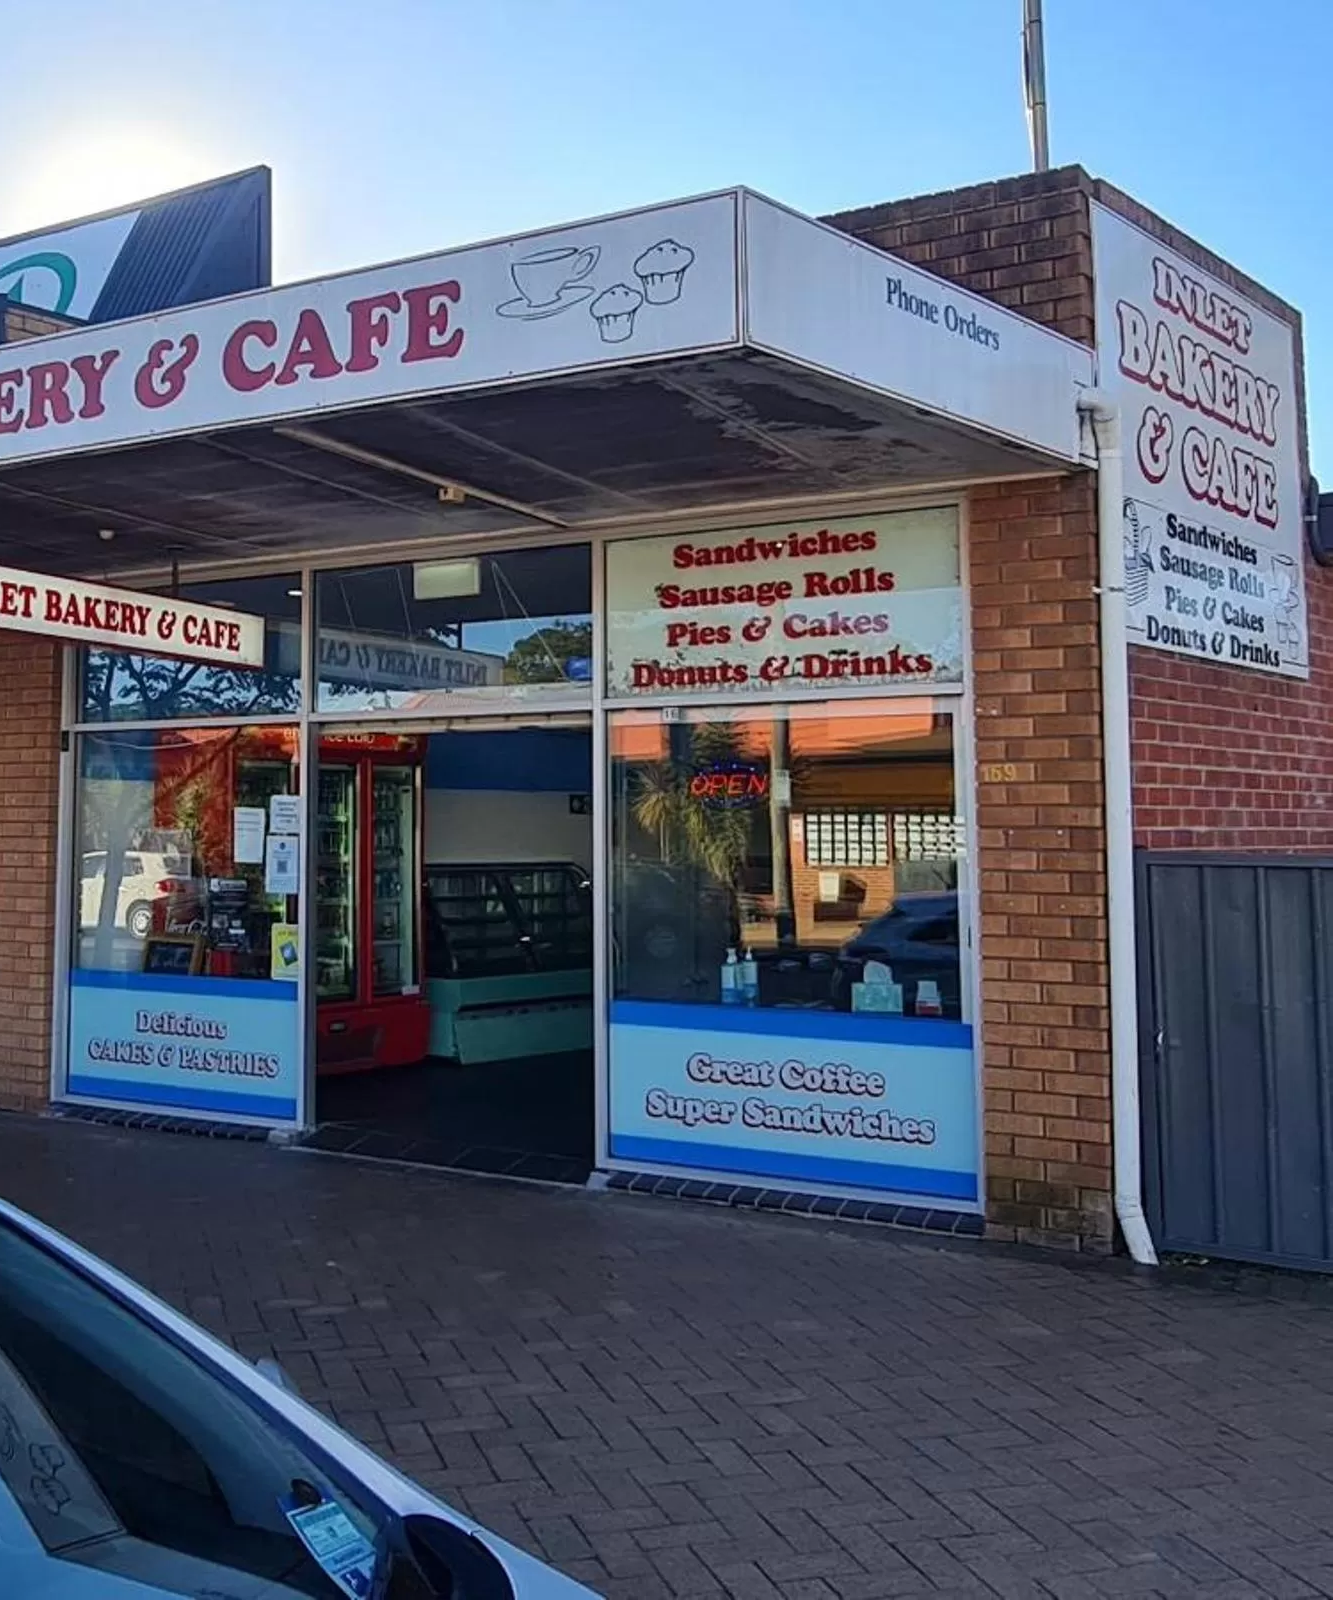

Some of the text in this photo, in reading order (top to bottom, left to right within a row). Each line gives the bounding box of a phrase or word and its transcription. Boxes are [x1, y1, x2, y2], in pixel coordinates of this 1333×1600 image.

[886, 277, 1000, 351] Phone Orders
[1153, 257, 1252, 354] INLET
[135, 334, 199, 408] &
[223, 281, 464, 391] CAFE
[1117, 299, 1279, 447] BAKERY
[1138, 405, 1279, 529] & CAFE
[673, 530, 877, 569] Sandwiches
[1167, 513, 1257, 565] Sandwiches
[658, 567, 895, 609] Sausage Rolls
[1160, 546, 1265, 599] Sausage Rolls
[45, 589, 151, 639] BAKERY
[157, 610, 177, 640] &
[182, 614, 242, 652] CAFE
[666, 610, 889, 647] Pies & Cakes
[1165, 586, 1265, 633] Pies & Cakes
[632, 645, 933, 688] Donuts & Drinks
[1146, 615, 1281, 667] Donuts & Drinks
[690, 772, 768, 797] OPEN
[136, 1009, 228, 1039] Delicious
[89, 1037, 280, 1078] CAKES & PASTRIES
[687, 1052, 886, 1096] Great Coffee
[645, 1088, 936, 1145] Super Sandwiches
